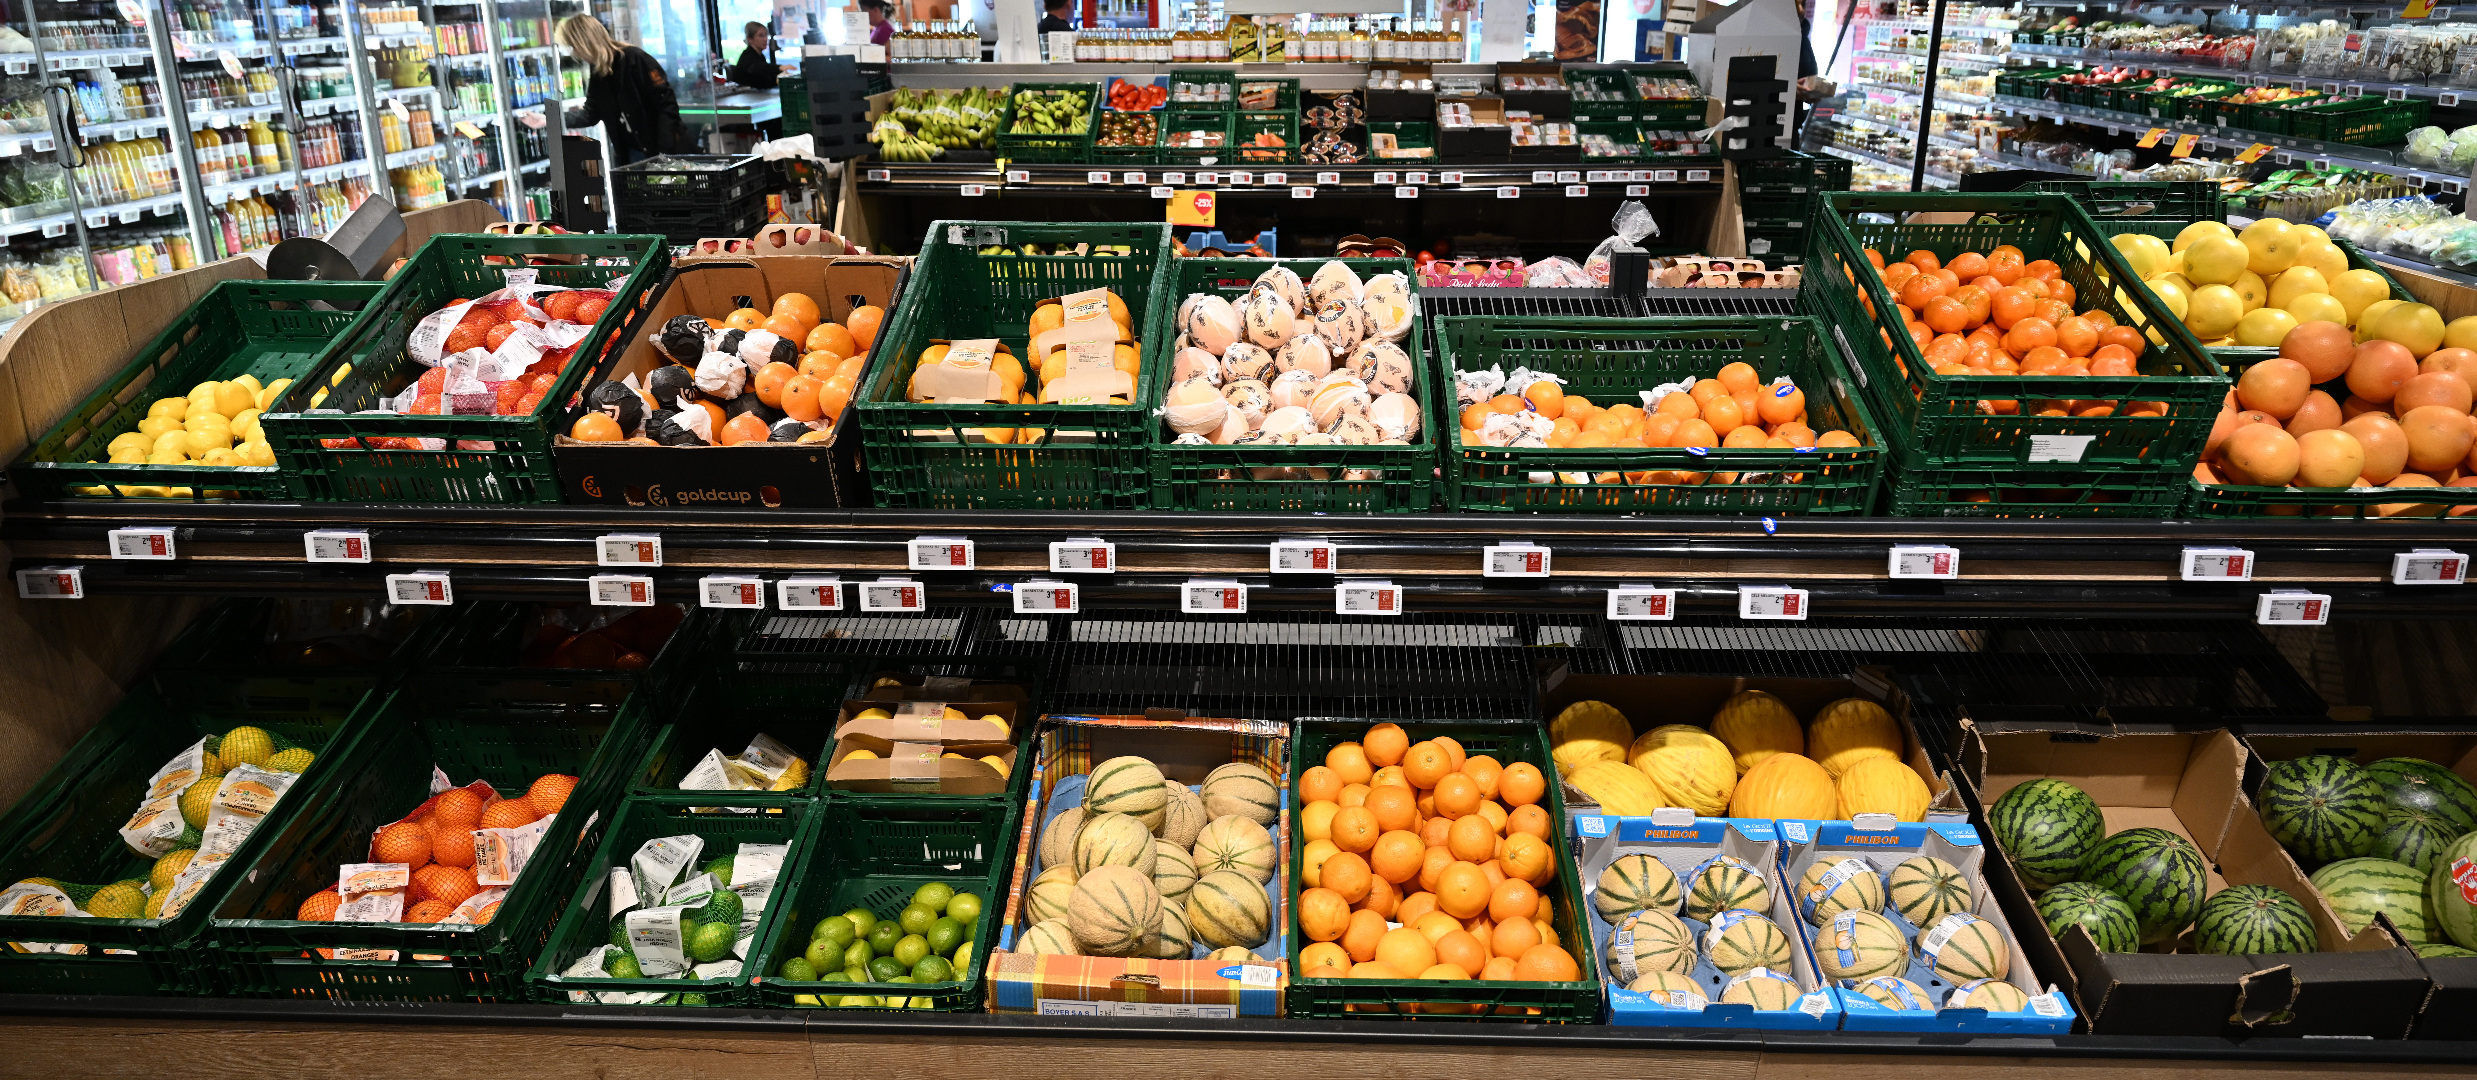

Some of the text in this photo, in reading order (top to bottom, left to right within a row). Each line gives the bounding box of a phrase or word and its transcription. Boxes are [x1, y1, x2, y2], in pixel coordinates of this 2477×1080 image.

[1195, 198, 1212, 208] -25%
[676, 488, 752, 504] goldcup
[1645, 829, 1699, 839] PHILIBON
[1845, 835, 1900, 845] PHILIBON
[351, 952, 379, 960] ORANGES
[1045, 1008, 1070, 1016] BOYER
